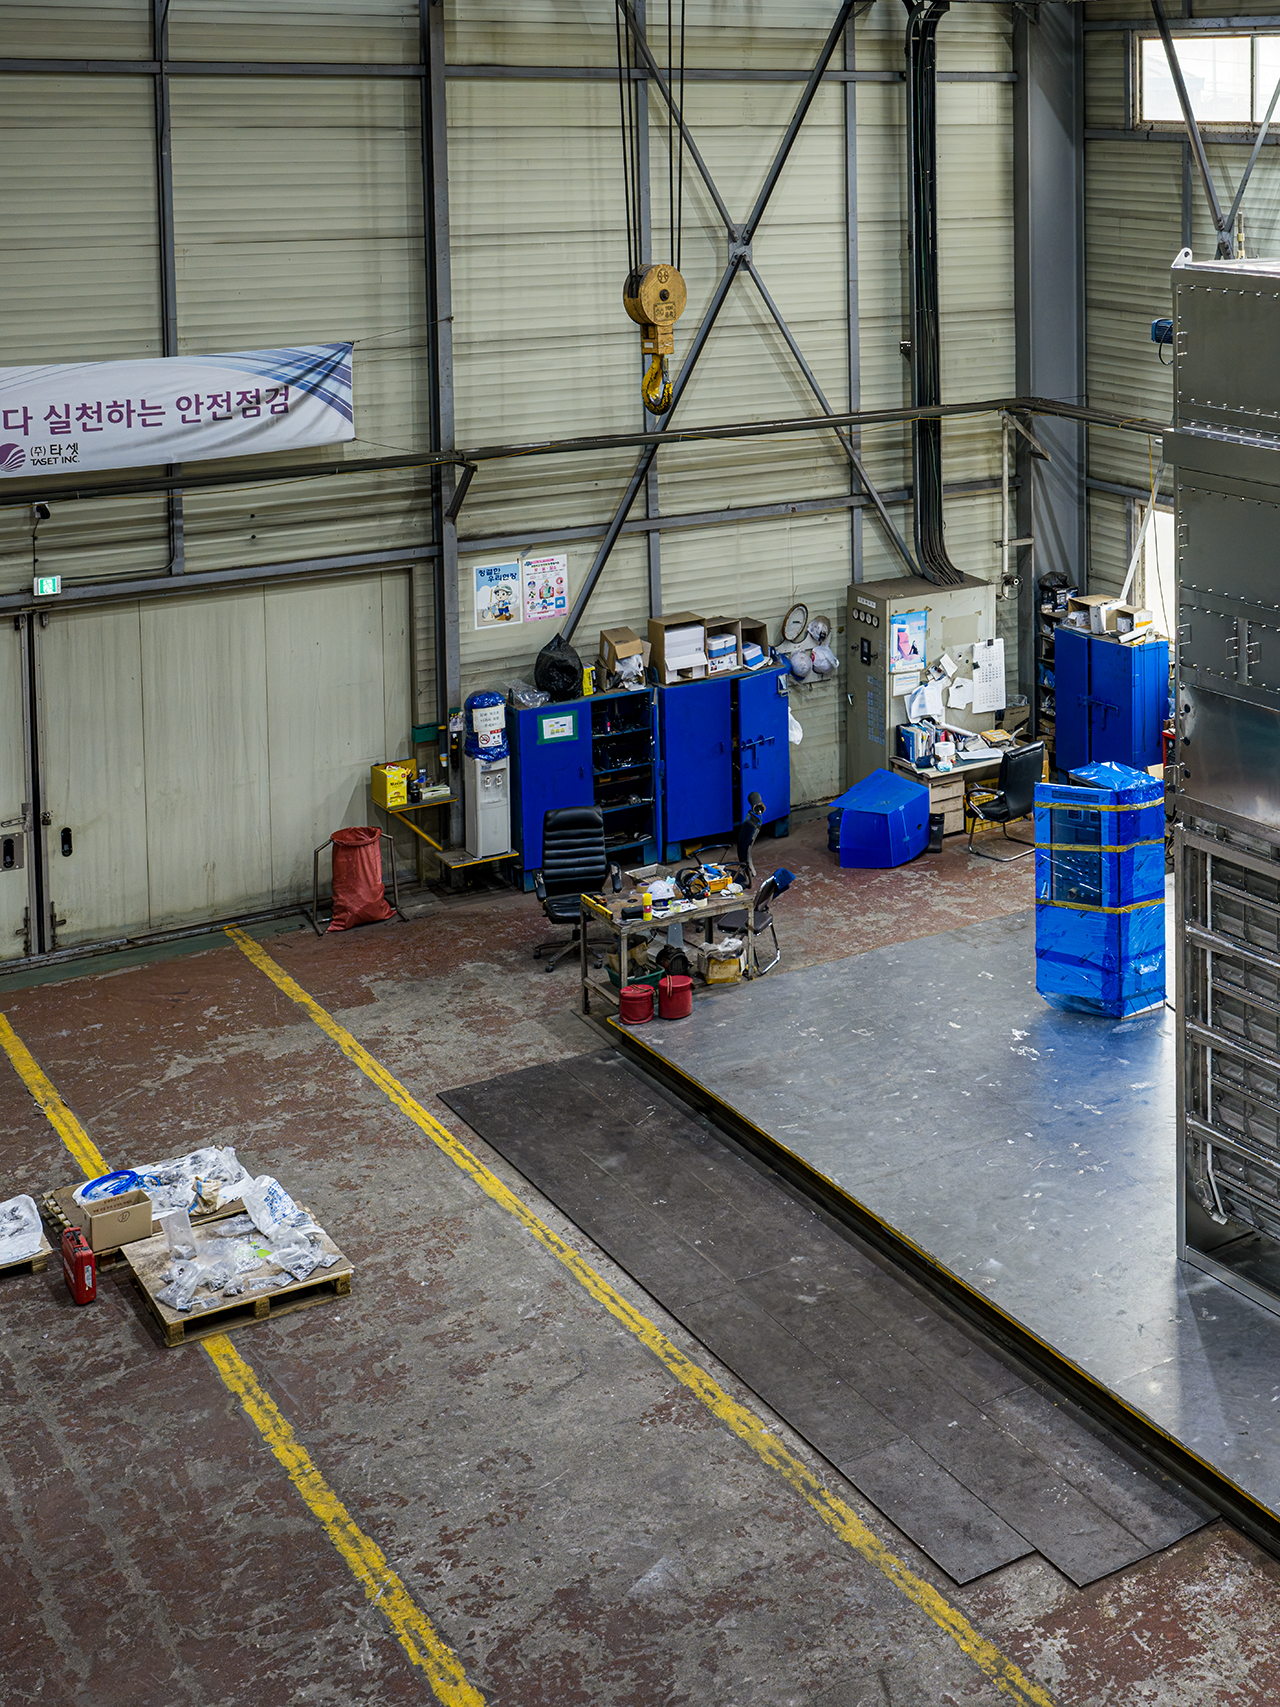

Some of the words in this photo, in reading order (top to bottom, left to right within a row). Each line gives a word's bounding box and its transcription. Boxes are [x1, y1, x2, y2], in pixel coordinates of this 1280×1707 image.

[2, 405, 33, 436] 다
[43, 399, 166, 436] 실천하는
[175, 385, 290, 424] 안전점검
[30, 457, 59, 466] TASET
[61, 455, 80, 464] INC.
